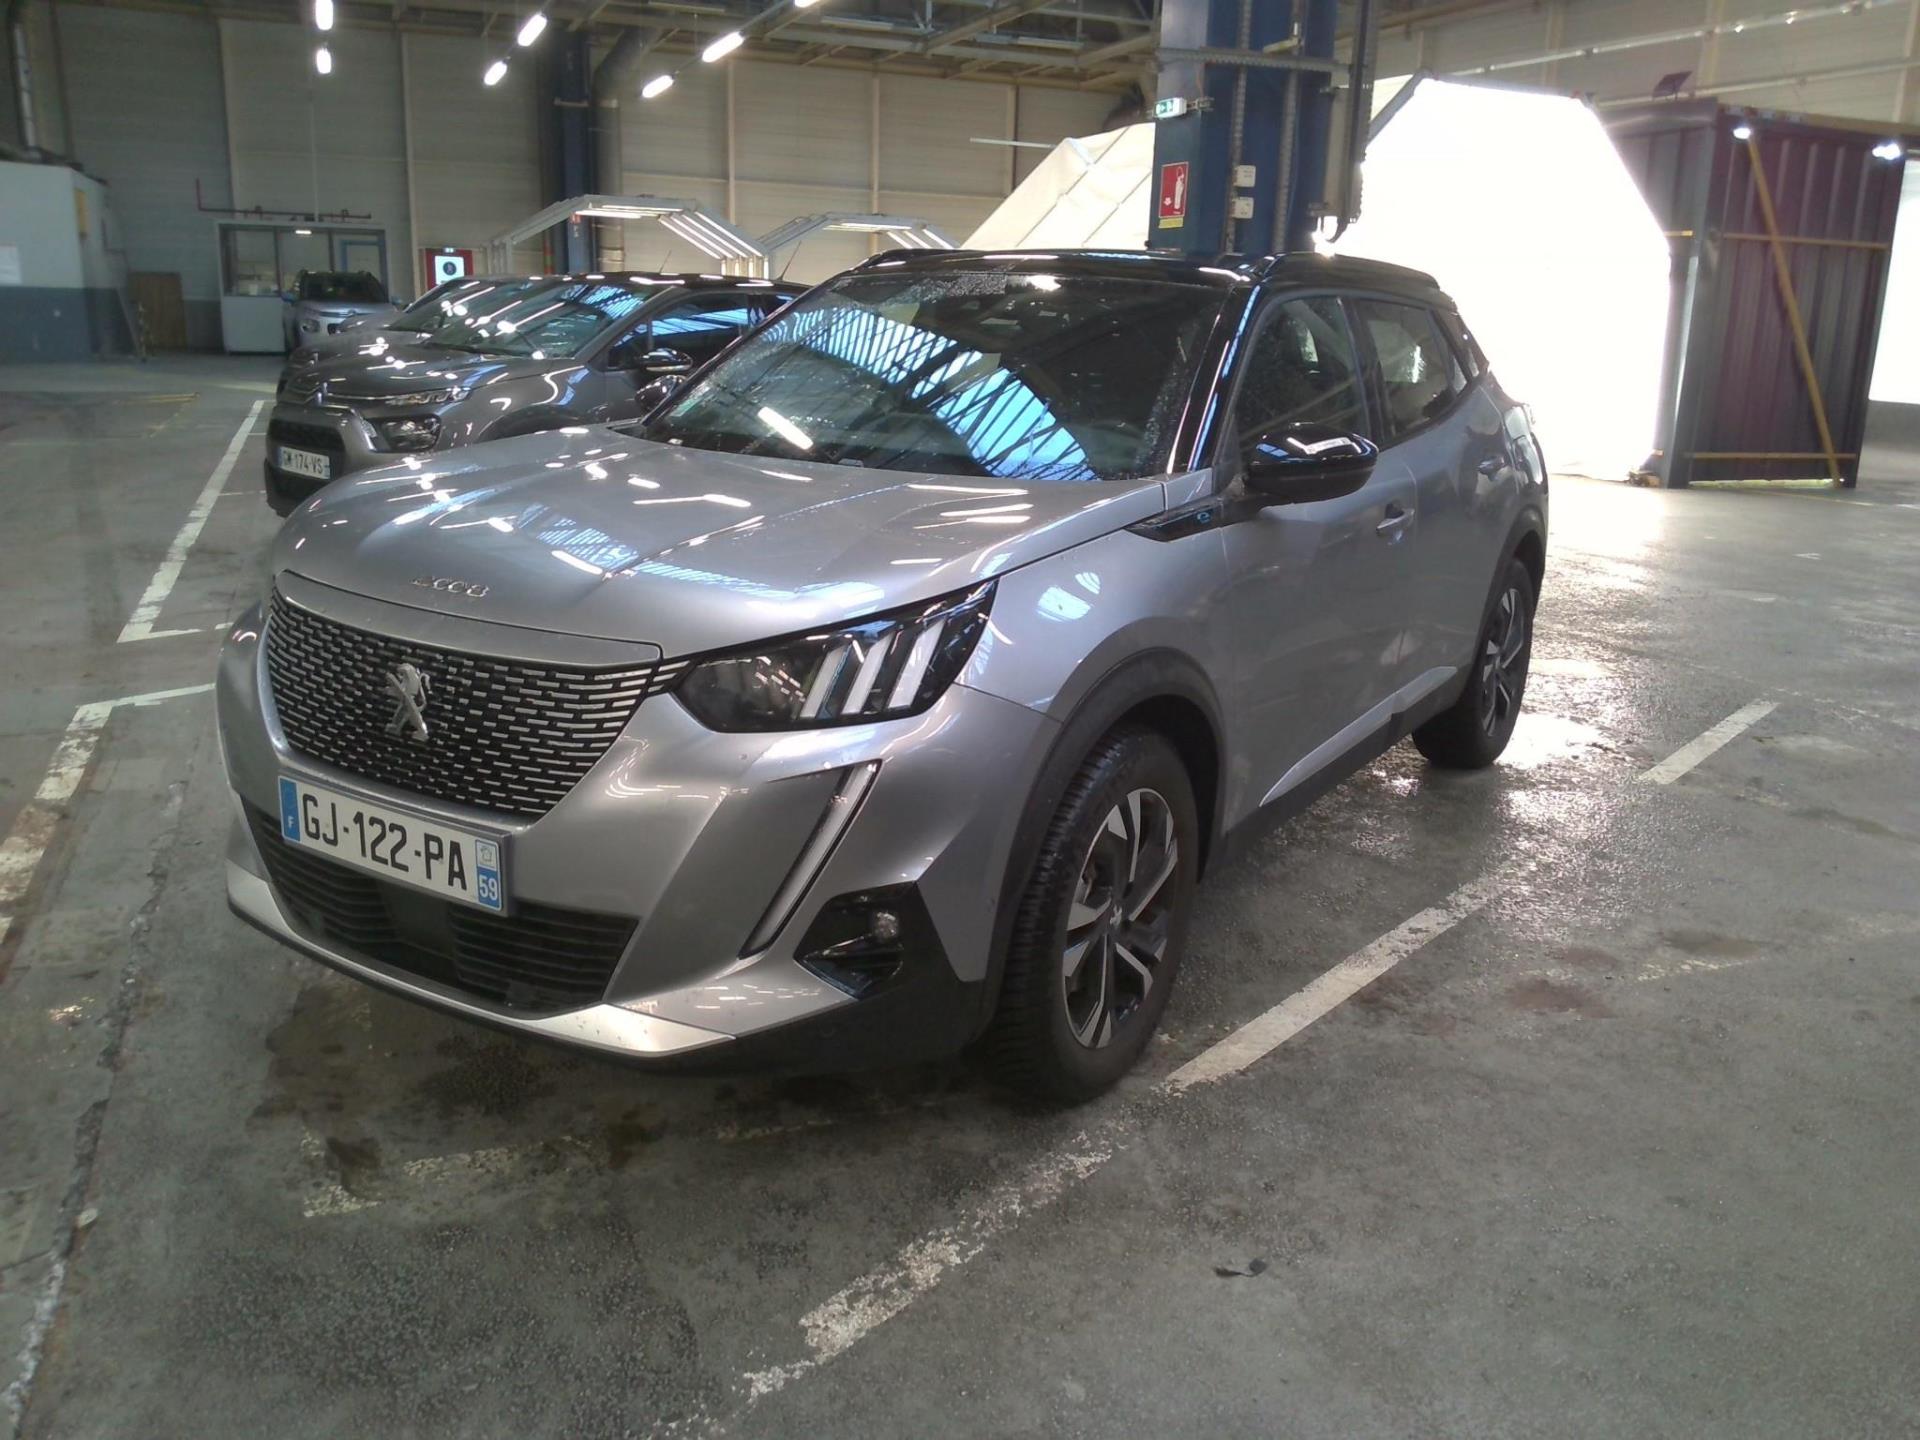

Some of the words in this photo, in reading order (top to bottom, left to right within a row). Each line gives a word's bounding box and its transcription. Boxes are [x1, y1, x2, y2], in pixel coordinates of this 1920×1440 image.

[287, 815, 295, 829] F
[302, 793, 467, 891] GJ-122-PA
[479, 875, 498, 901] 59
